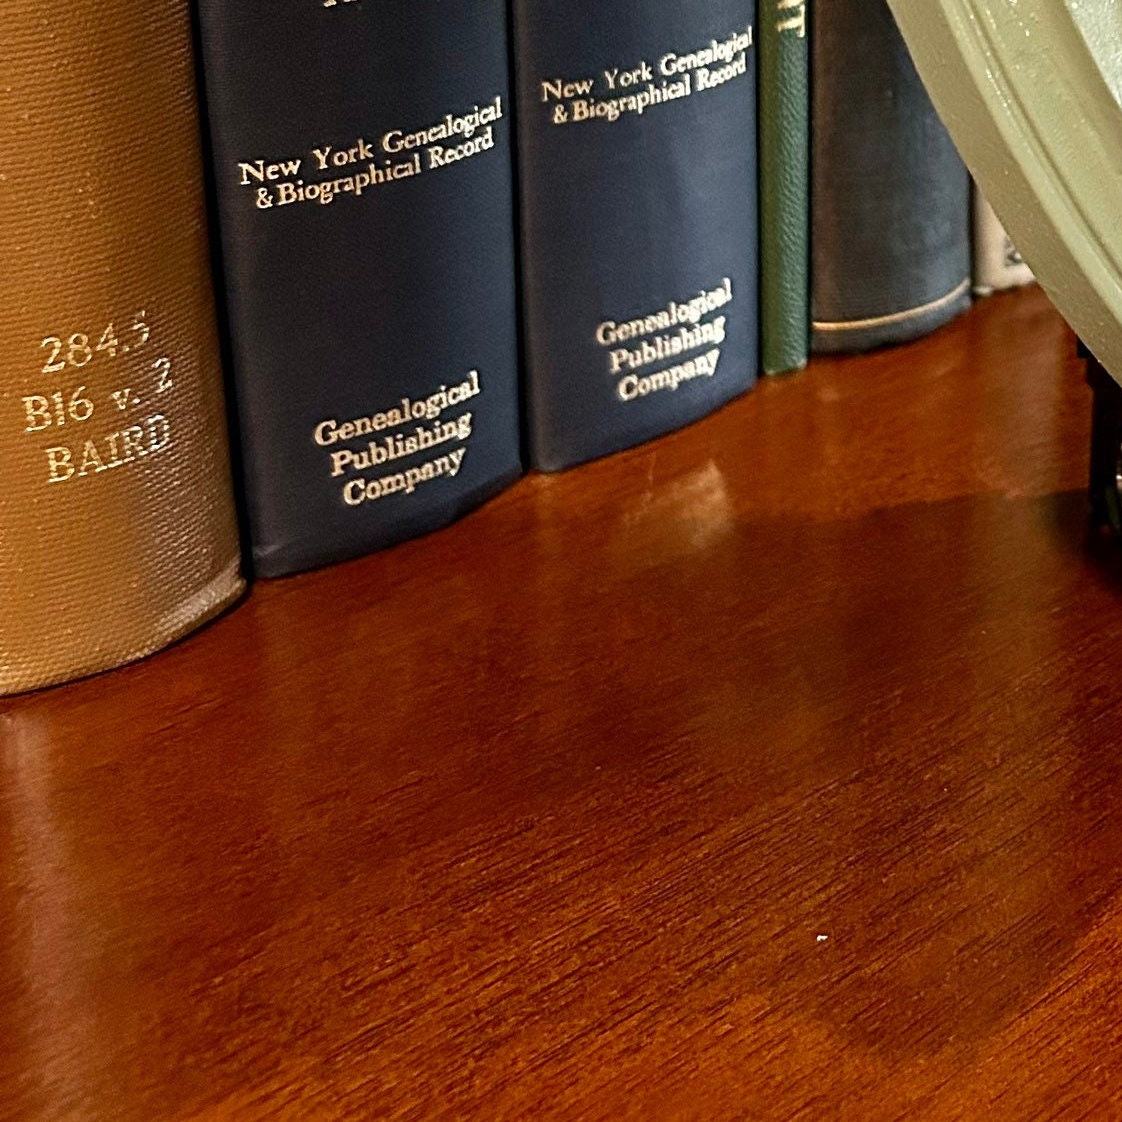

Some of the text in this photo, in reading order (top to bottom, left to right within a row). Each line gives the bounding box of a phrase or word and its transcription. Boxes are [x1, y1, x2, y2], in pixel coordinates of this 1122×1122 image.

[541, 25, 754, 104] New York Genealogical
[696, 53, 747, 91] Record
[239, 96, 503, 186] New York Genealogical
[428, 127, 495, 169] Record
[596, 277, 733, 346] Genealogical
[608, 314, 727, 375] Publishing
[21, 385, 94, 432] B16
[151, 357, 173, 394] 2
[313, 369, 481, 447] Genealogical
[617, 348, 720, 403] Company
[45, 414, 172, 482] BAIRD
[329, 412, 474, 478] Publishing
[343, 446, 467, 508] Company
